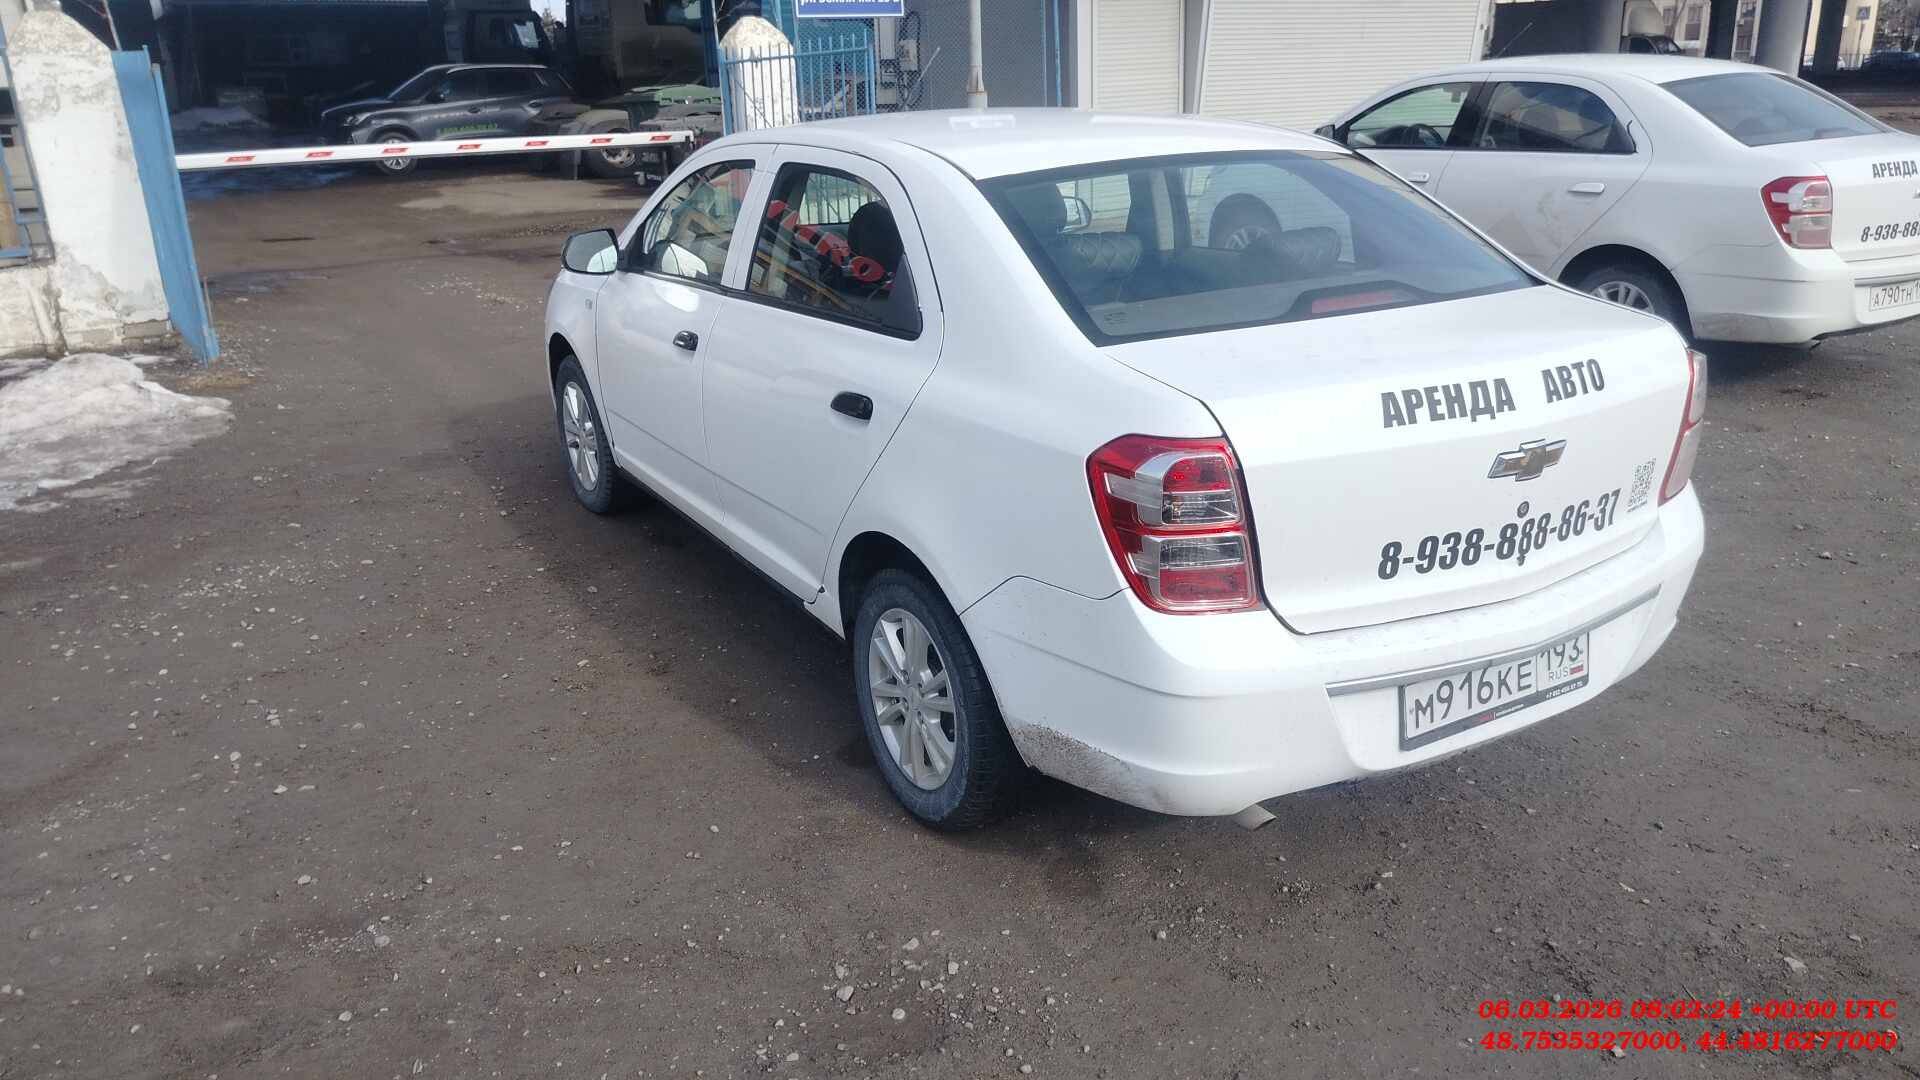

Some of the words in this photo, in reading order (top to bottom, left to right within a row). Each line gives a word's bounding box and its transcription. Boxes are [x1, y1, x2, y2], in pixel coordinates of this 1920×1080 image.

[1872, 160, 1918, 179] АРЕНДА
[1861, 220, 1920, 243] 8-938-88
[1381, 377, 1516, 429] АРЕНДА
[1541, 358, 1605, 404] АВТО
[1378, 488, 1622, 579] 8-938-888-86-37
[1414, 660, 1532, 729] М916КЕ
[1547, 668, 1569, 681] RUS
